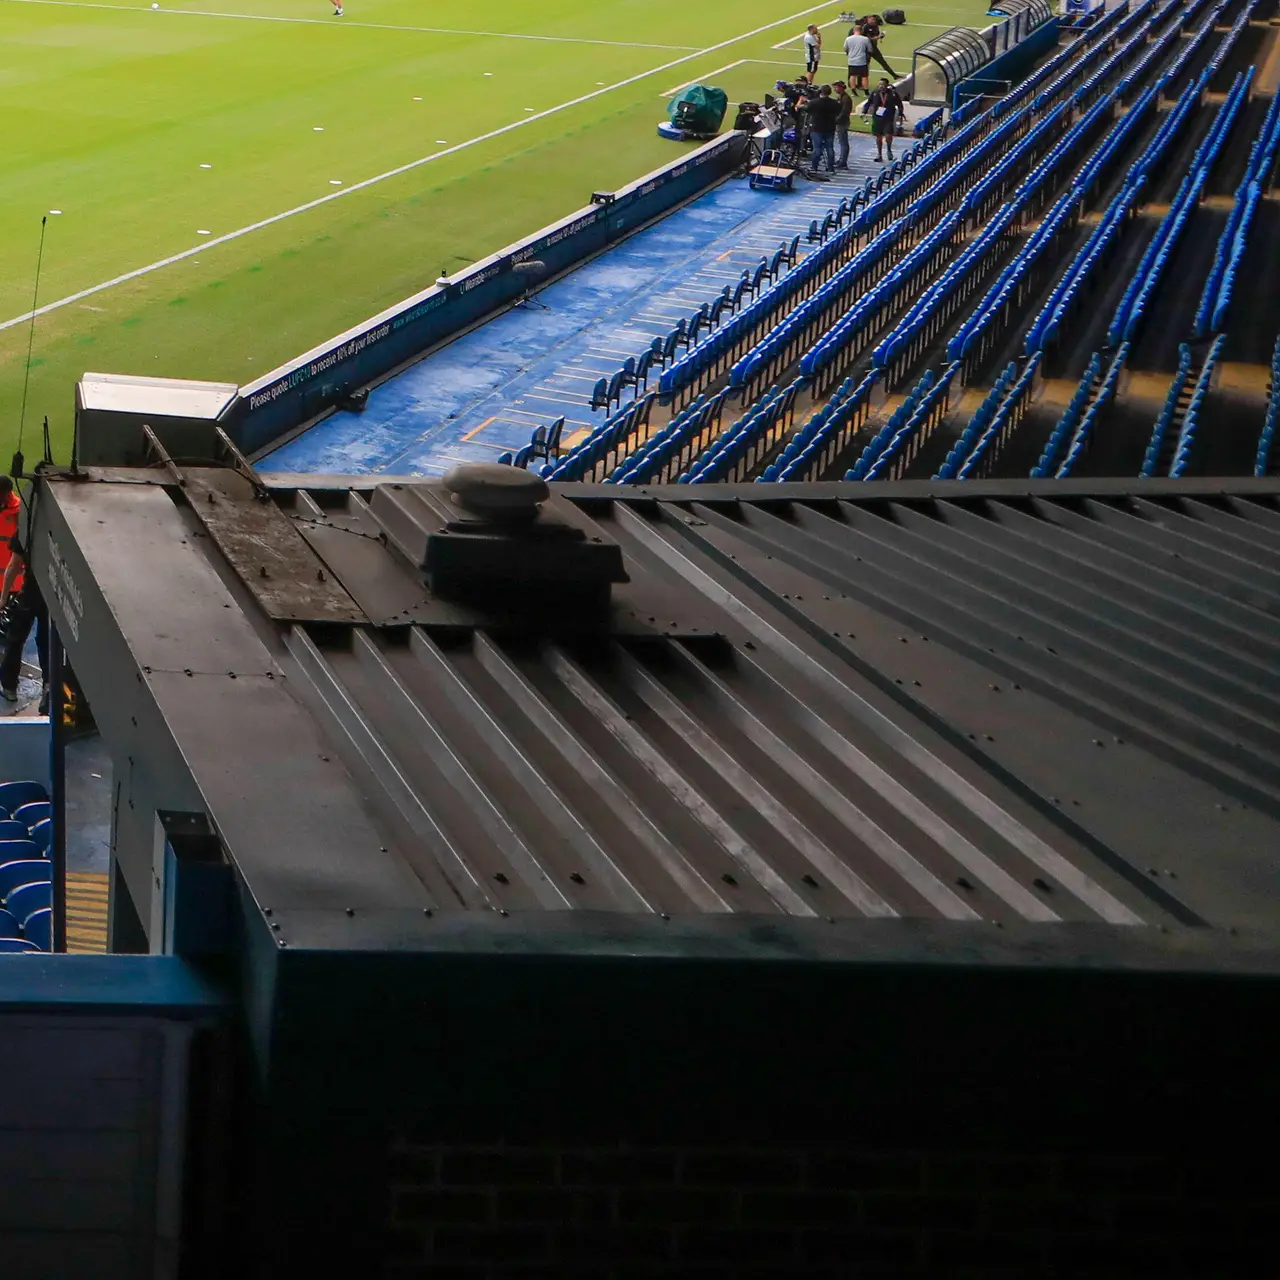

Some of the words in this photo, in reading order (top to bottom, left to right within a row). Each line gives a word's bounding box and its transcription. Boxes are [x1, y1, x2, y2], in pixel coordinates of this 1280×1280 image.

[250, 392, 271, 410] Please
[271, 380, 289, 400] quote
[316, 354, 337, 373] receive
[354, 335, 367, 355] your
